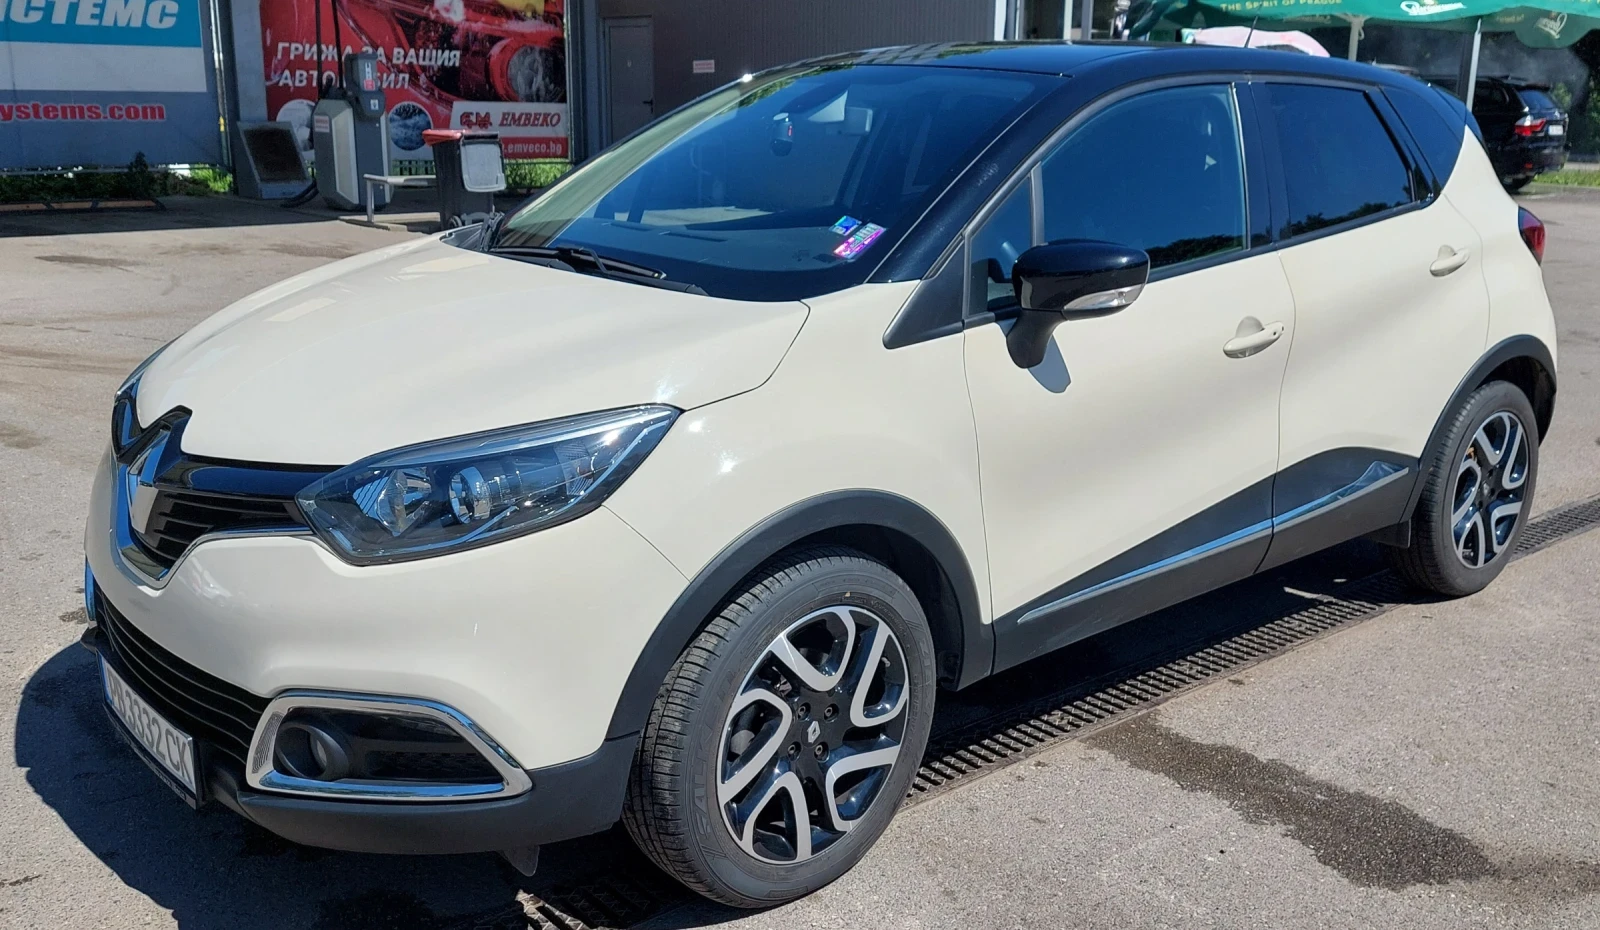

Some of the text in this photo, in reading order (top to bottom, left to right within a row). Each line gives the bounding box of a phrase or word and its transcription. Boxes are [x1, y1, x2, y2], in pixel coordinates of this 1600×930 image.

[0, 0, 179, 29] СТЕМС
[1220, 3, 1242, 11] THE
[392, 47, 461, 67] ВАШИЯ
[278, 69, 409, 89] АВТОИЛ
[0, 102, 165, 121] ystems.com
[502, 142, 562, 155] .emveco.bg
